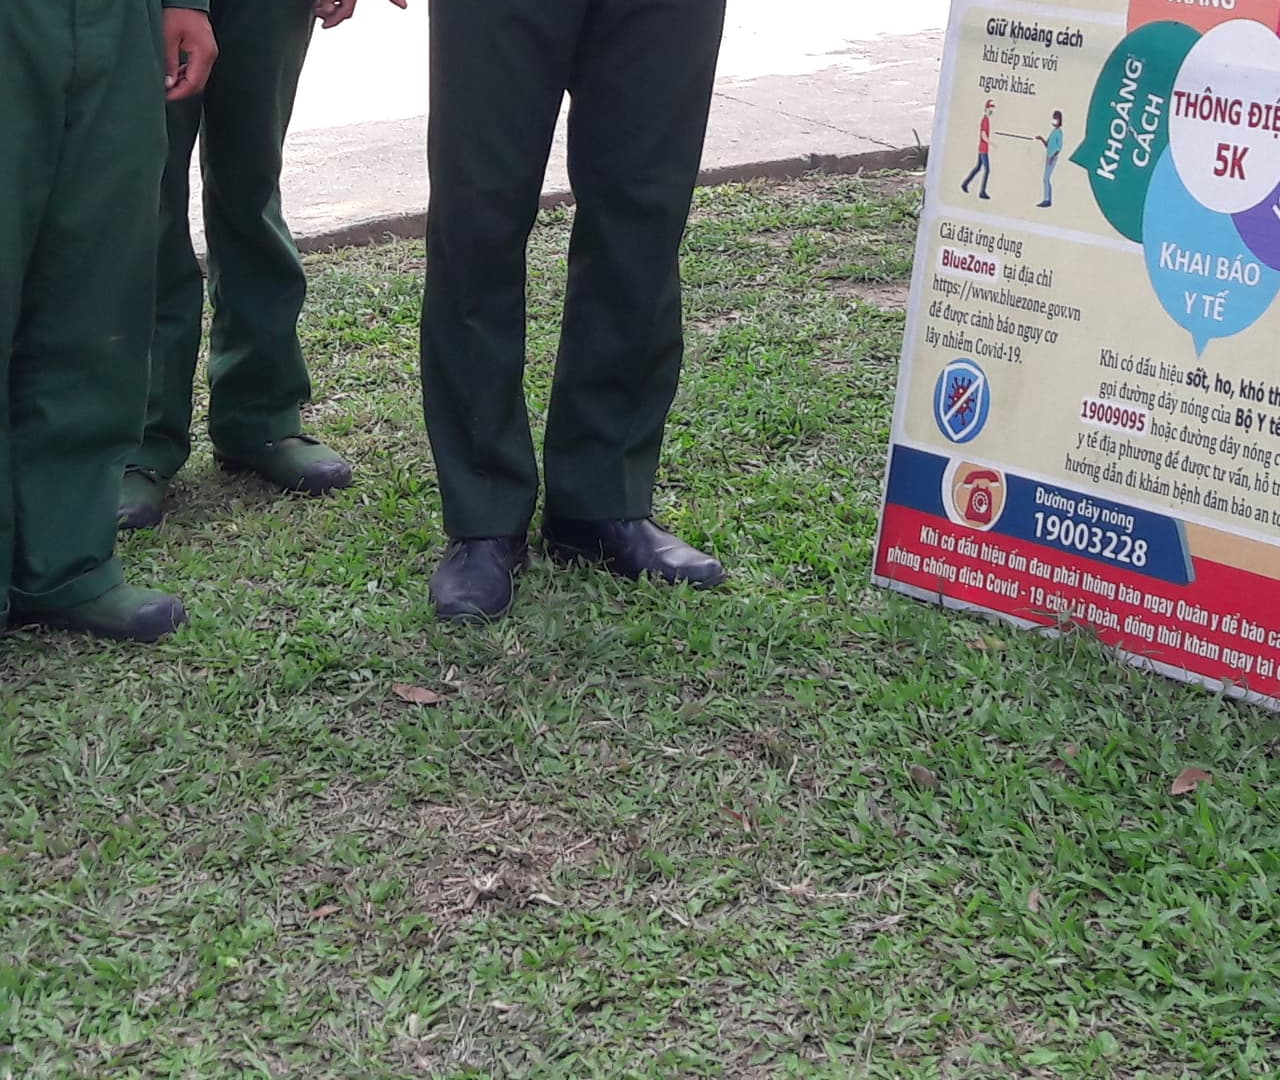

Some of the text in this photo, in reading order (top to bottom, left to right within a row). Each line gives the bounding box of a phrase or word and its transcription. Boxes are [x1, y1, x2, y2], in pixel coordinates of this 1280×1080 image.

[987, 18, 1083, 48] Giữ khoảng cách
[1096, 53, 1164, 181] KHOẢNG CÁCH
[1174, 86, 1242, 126] THÔNG
[1213, 142, 1250, 180] 5K
[942, 249, 996, 276] BlueZone
[1159, 241, 1260, 286] KHAI BÁO
[932, 273, 1081, 321] https://www.bluezone.gov.vn
[1184, 290, 1229, 321] Y TẾ
[1081, 400, 1146, 432] 19009095
[1035, 487, 1134, 532] Đường dây nóng
[1034, 512, 1148, 567] 19003228
